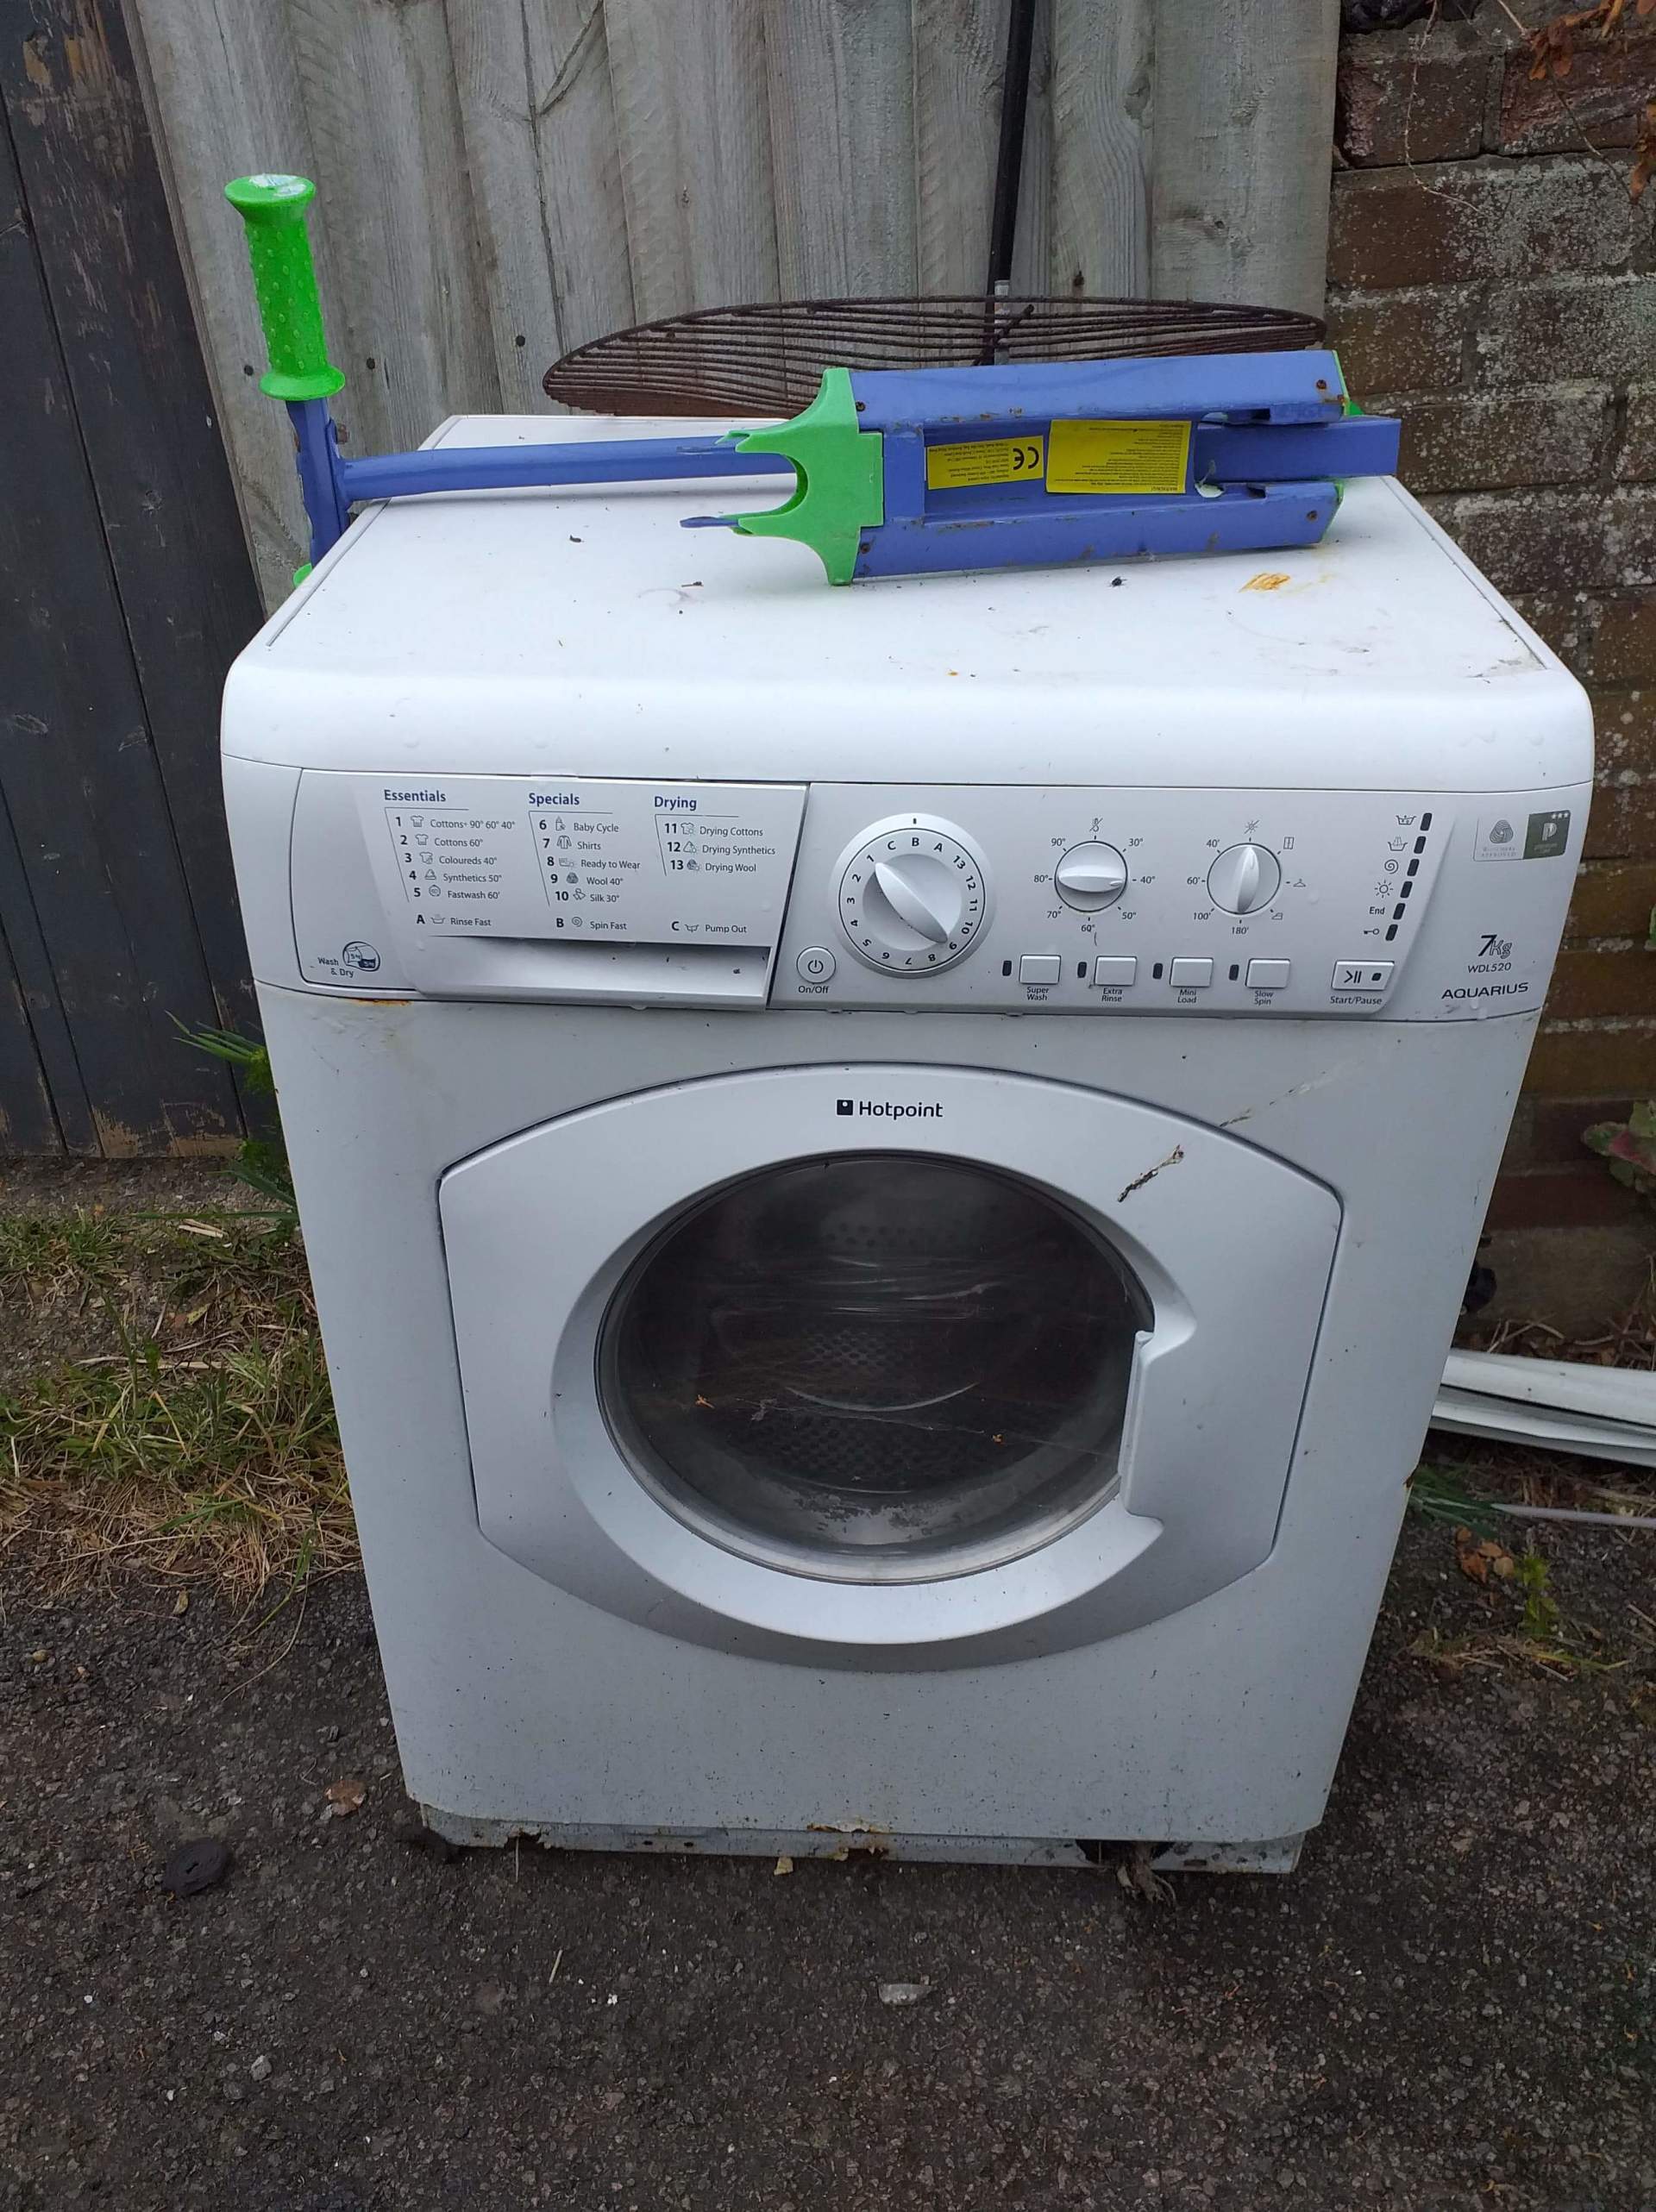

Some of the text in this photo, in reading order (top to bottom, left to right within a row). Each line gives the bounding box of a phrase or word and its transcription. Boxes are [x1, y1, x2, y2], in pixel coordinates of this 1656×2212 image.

[384, 789, 446, 801] Essentials
[529, 793, 580, 807] Specials
[655, 796, 696, 811] Drying
[396, 817, 401, 826] 1
[539, 820, 618, 834] 6 Baby Cycle
[665, 824, 762, 837] 11 Drying Cottons
[400, 835, 407, 845] 2
[435, 837, 468, 847] Cottons
[543, 838, 549, 848] 7
[888, 841, 896, 849] C
[912, 837, 919, 846] B
[668, 842, 775, 855] 12 Drying Synthetics
[934, 843, 942, 852] A
[405, 853, 411, 862] 3
[439, 855, 481, 864] Coloureds
[548, 856, 555, 866] 8
[581, 860, 606, 869] Ready
[618, 861, 640, 871] Wear
[953, 855, 965, 869] 13
[670, 860, 683, 870] 13
[706, 863, 733, 873] Drying
[409, 871, 417, 880] 4
[443, 874, 486, 883] Synthetics
[550, 874, 558, 883] 9
[966, 875, 975, 890] 12
[414, 887, 420, 897] 5
[555, 891, 568, 900] 10
[969, 899, 977, 911] 11
[1370, 906, 1385, 915] End
[417, 915, 425, 924] A
[556, 918, 564, 927] B
[590, 921, 608, 931] Spin
[672, 921, 679, 931] C
[706, 924, 729, 935] Pump
[317, 957, 339, 966] Wash
[339, 968, 354, 978] Dry
[1468, 962, 1511, 973] WDL520
[1027, 987, 1049, 996] Super
[1102, 987, 1123, 995] Extra
[1178, 987, 1196, 996] Mini
[1441, 982, 1528, 999] AQUARIUS
[1254, 998, 1271, 1006] Spin
[1330, 996, 1383, 1006] Start/Pause
[860, 1101, 943, 1120] Hotpoint
